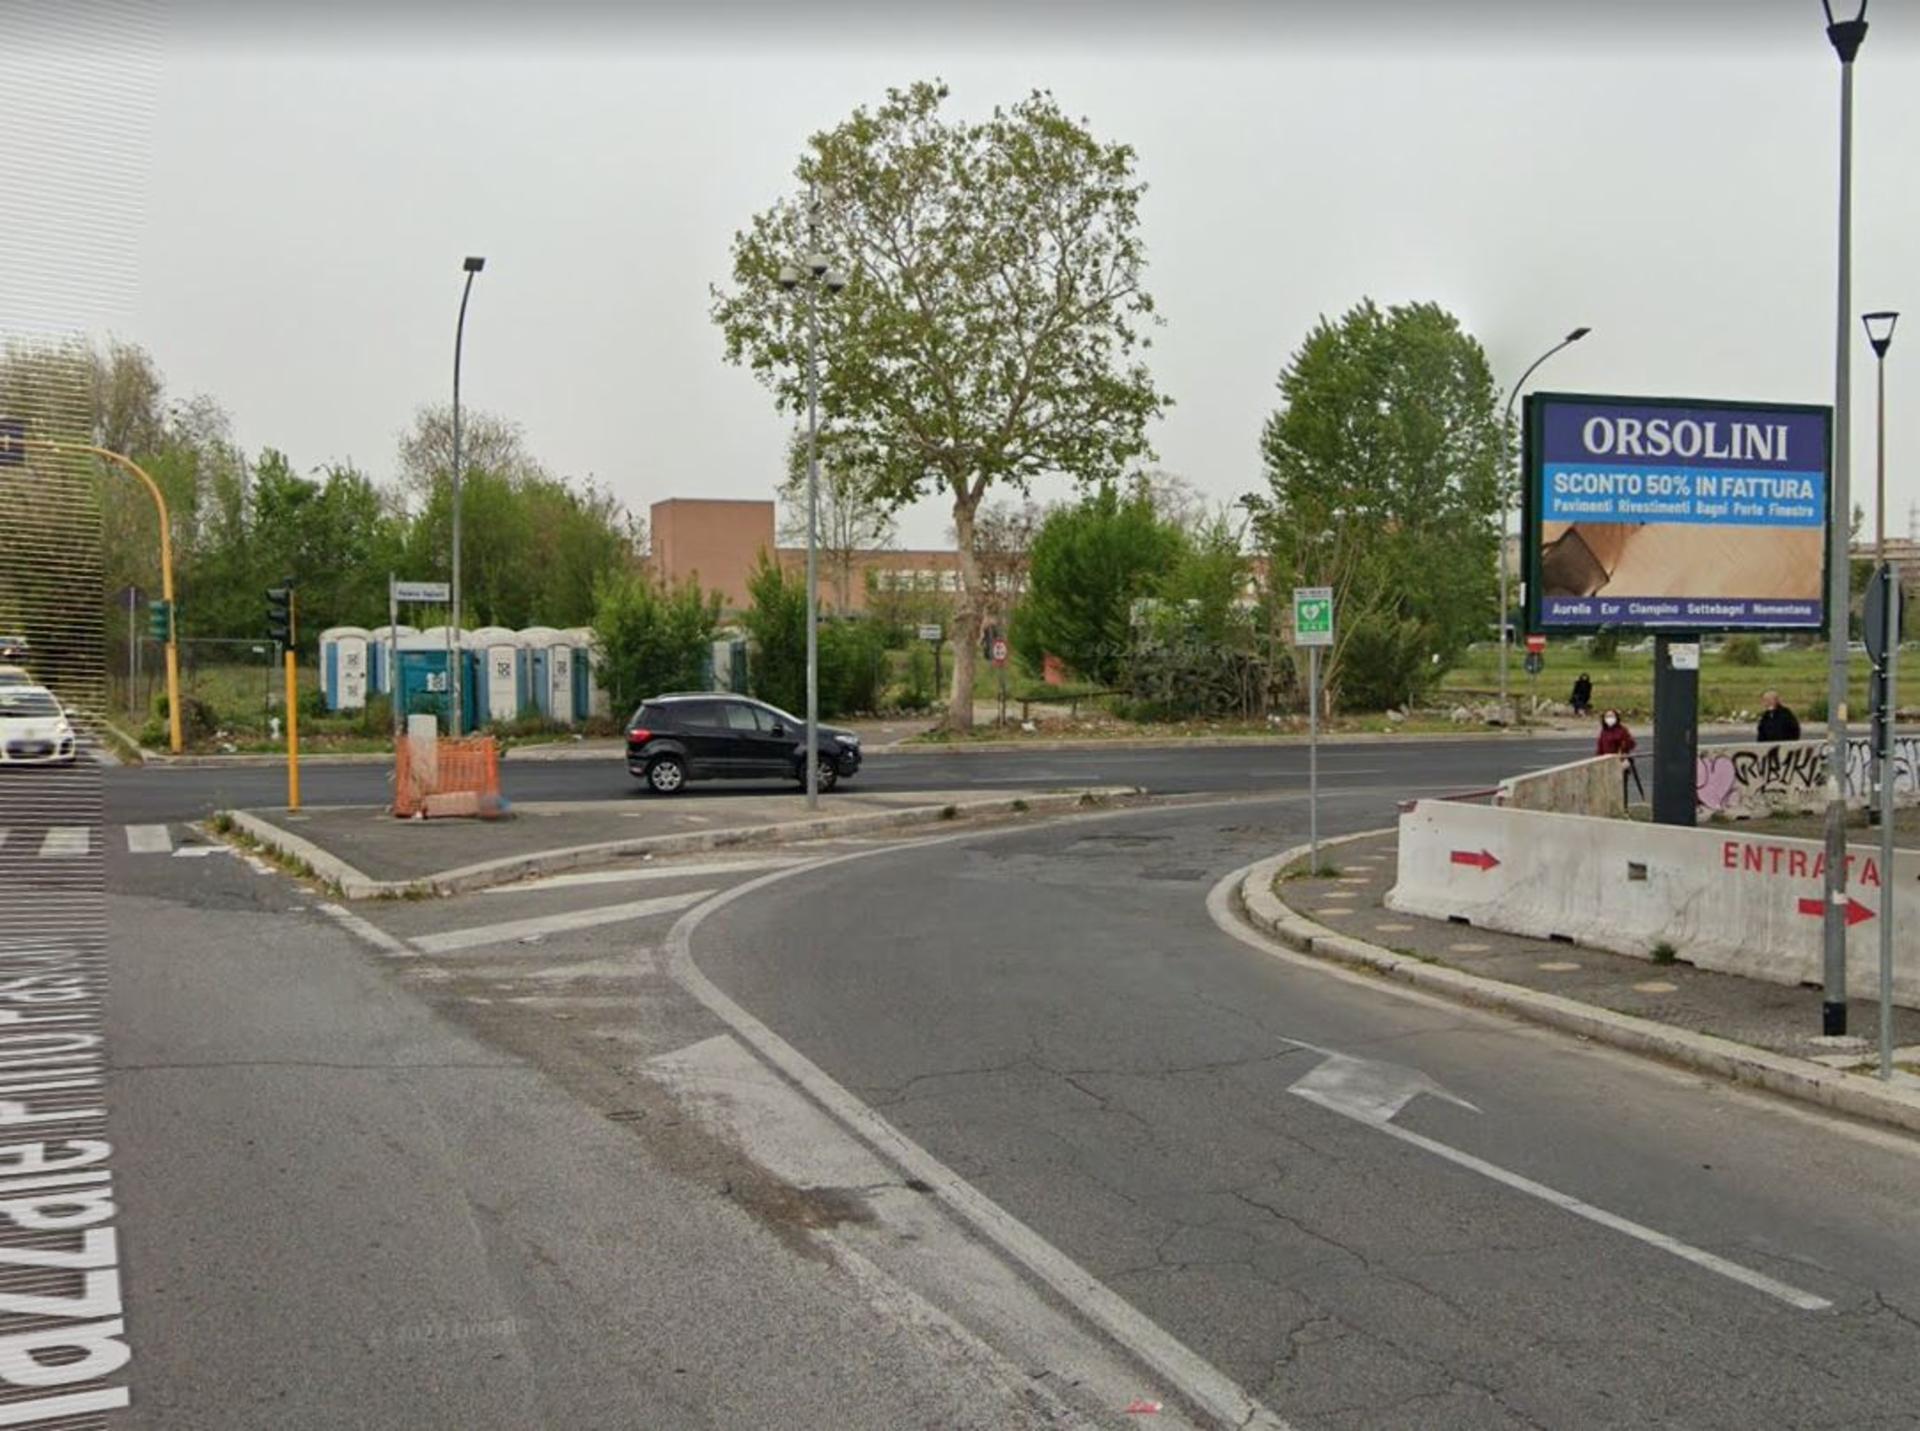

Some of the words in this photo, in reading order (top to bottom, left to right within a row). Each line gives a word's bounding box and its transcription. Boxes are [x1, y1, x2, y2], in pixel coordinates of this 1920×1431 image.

[1583, 416, 1788, 461] ORSOLINI
[1554, 473, 1641, 494] SCONTO
[1647, 474, 1690, 496] 50%
[1696, 475, 1717, 497] IN
[1722, 477, 1814, 499] FATTURA
[1554, 498, 1613, 512] Pavimenti
[1618, 499, 1690, 514] Rivestimenti
[1696, 501, 1728, 517] Bagni
[1733, 502, 1763, 515] Porte
[1768, 503, 1814, 517] Finestre
[1552, 602, 1591, 615] Aurelia
[1601, 603, 1620, 615] Eur
[1628, 603, 1679, 617] Ciampino
